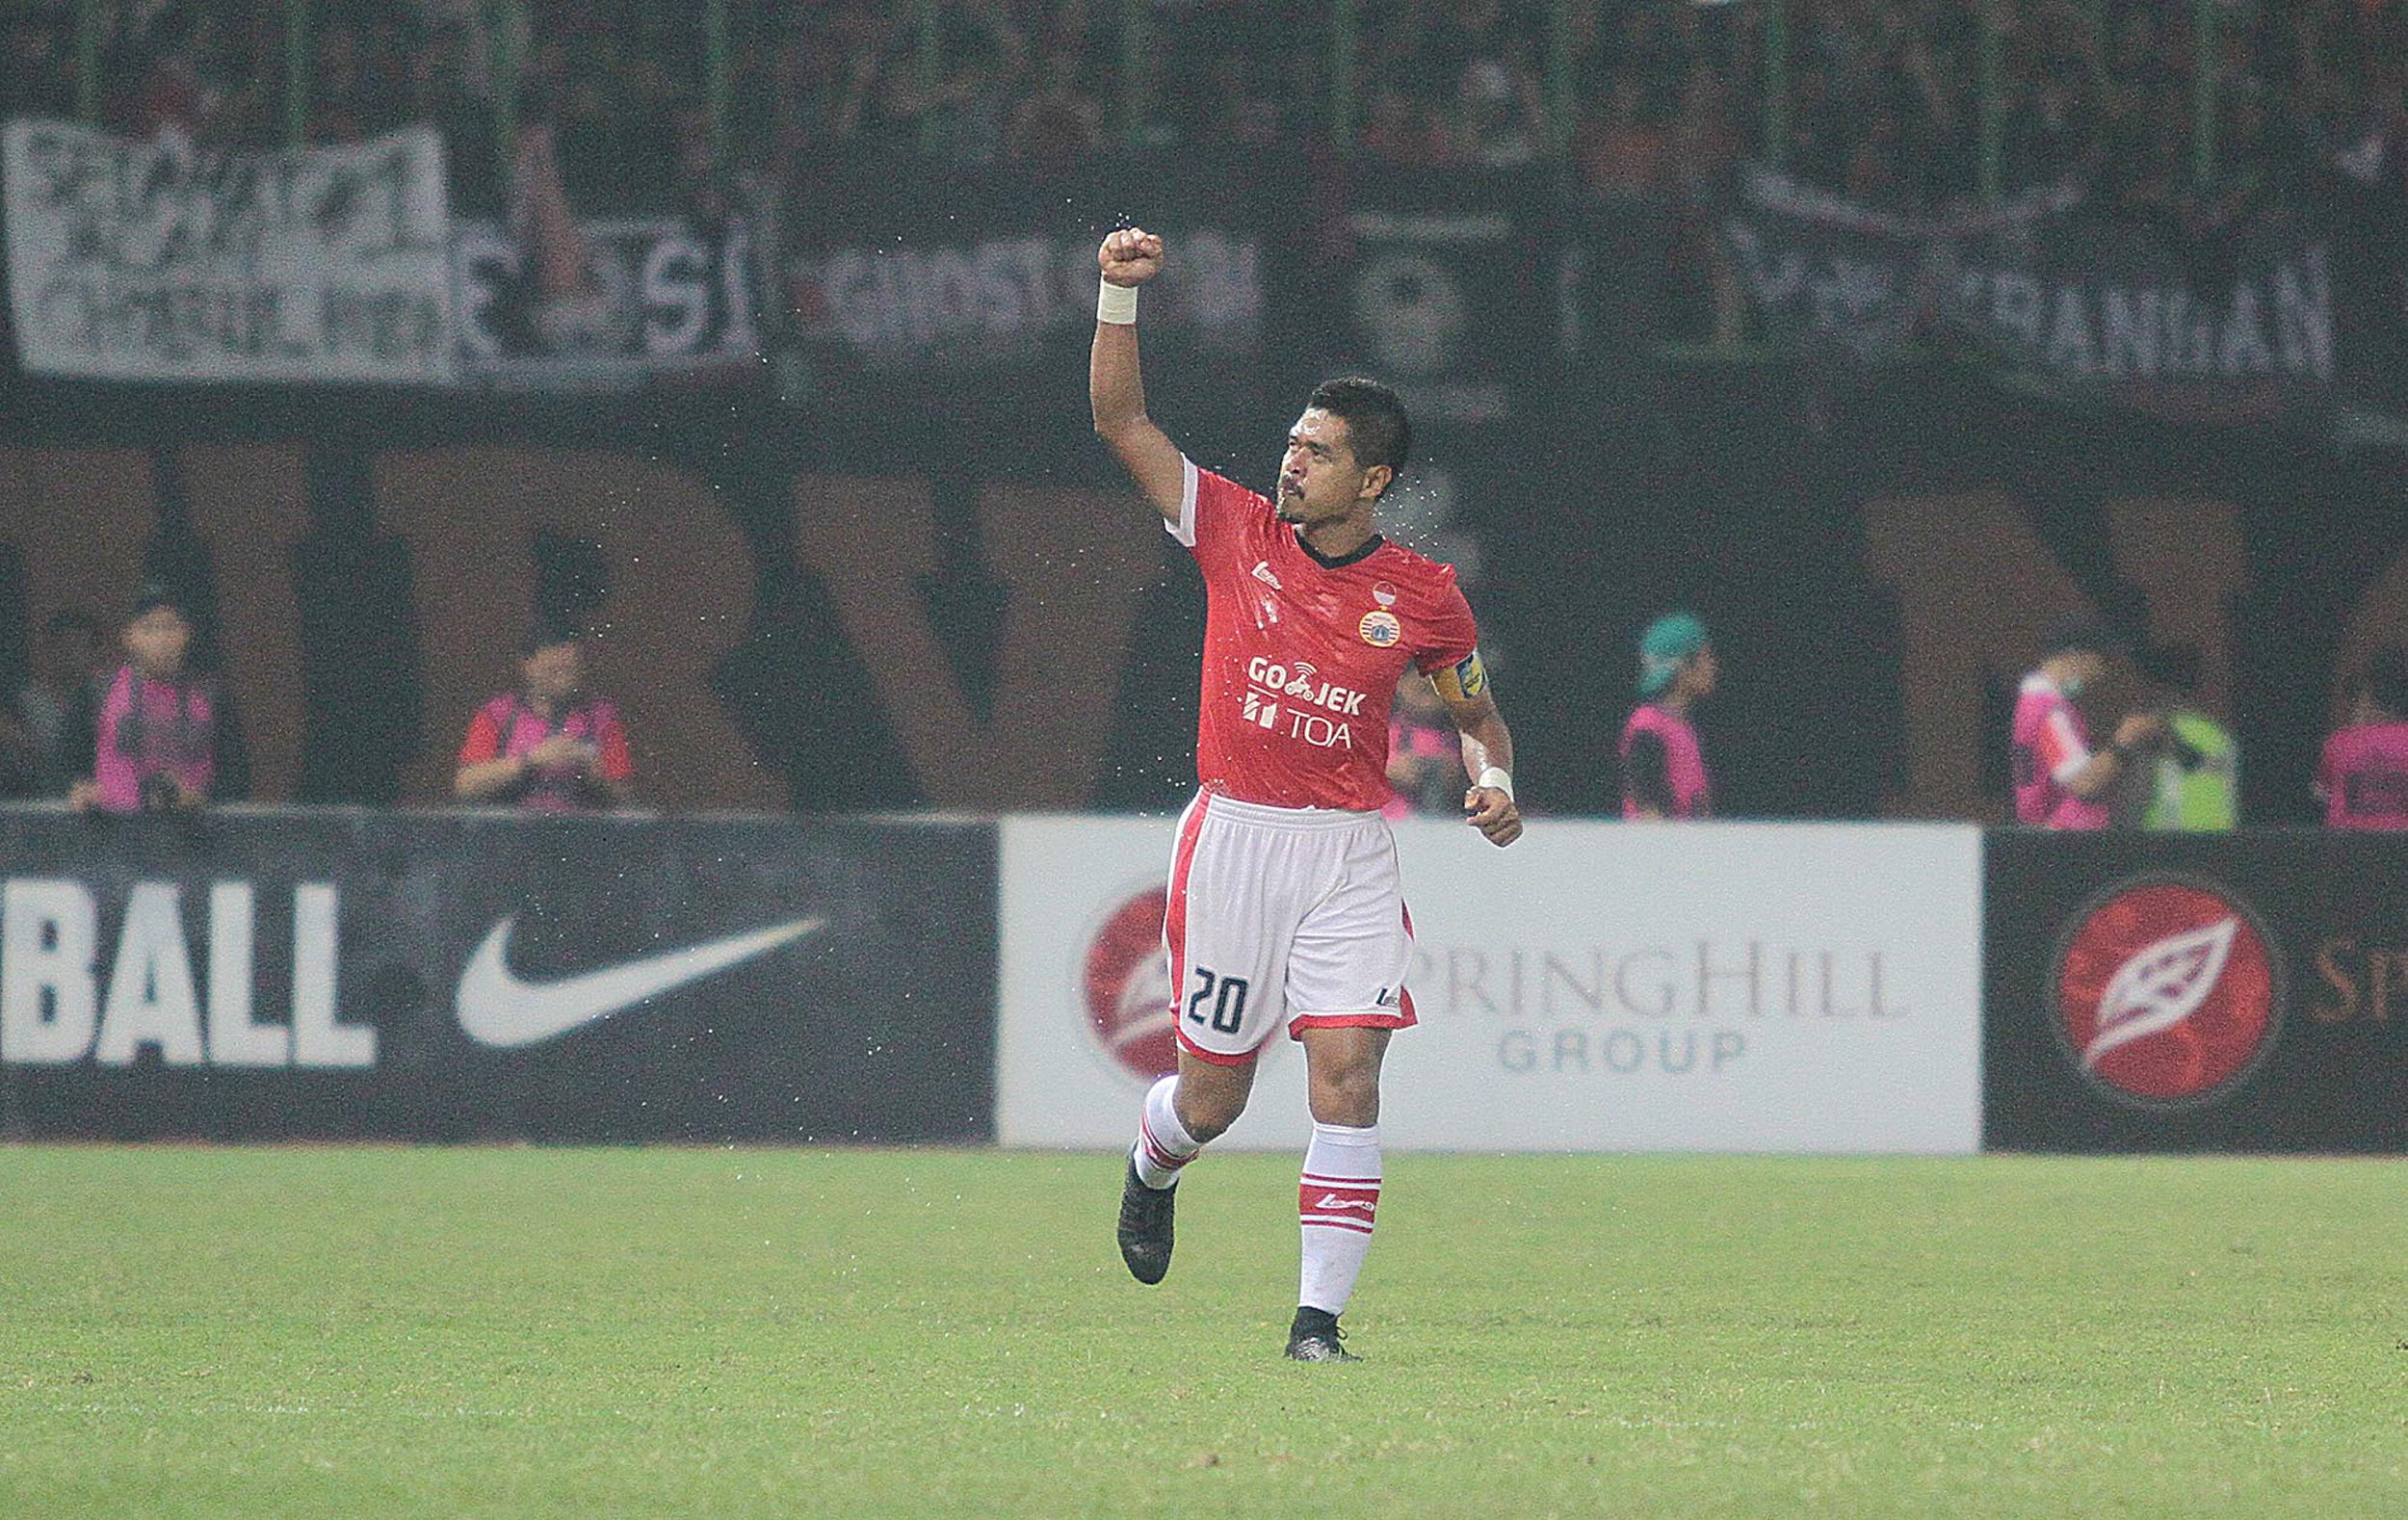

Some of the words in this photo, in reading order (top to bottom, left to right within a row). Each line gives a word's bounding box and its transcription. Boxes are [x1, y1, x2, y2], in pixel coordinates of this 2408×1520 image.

[1287, 708, 1351, 748] TOA
[2, 880, 378, 1065] BALL
[1187, 964, 1248, 1035] 20
[1496, 1028, 1747, 1075] GROUP
